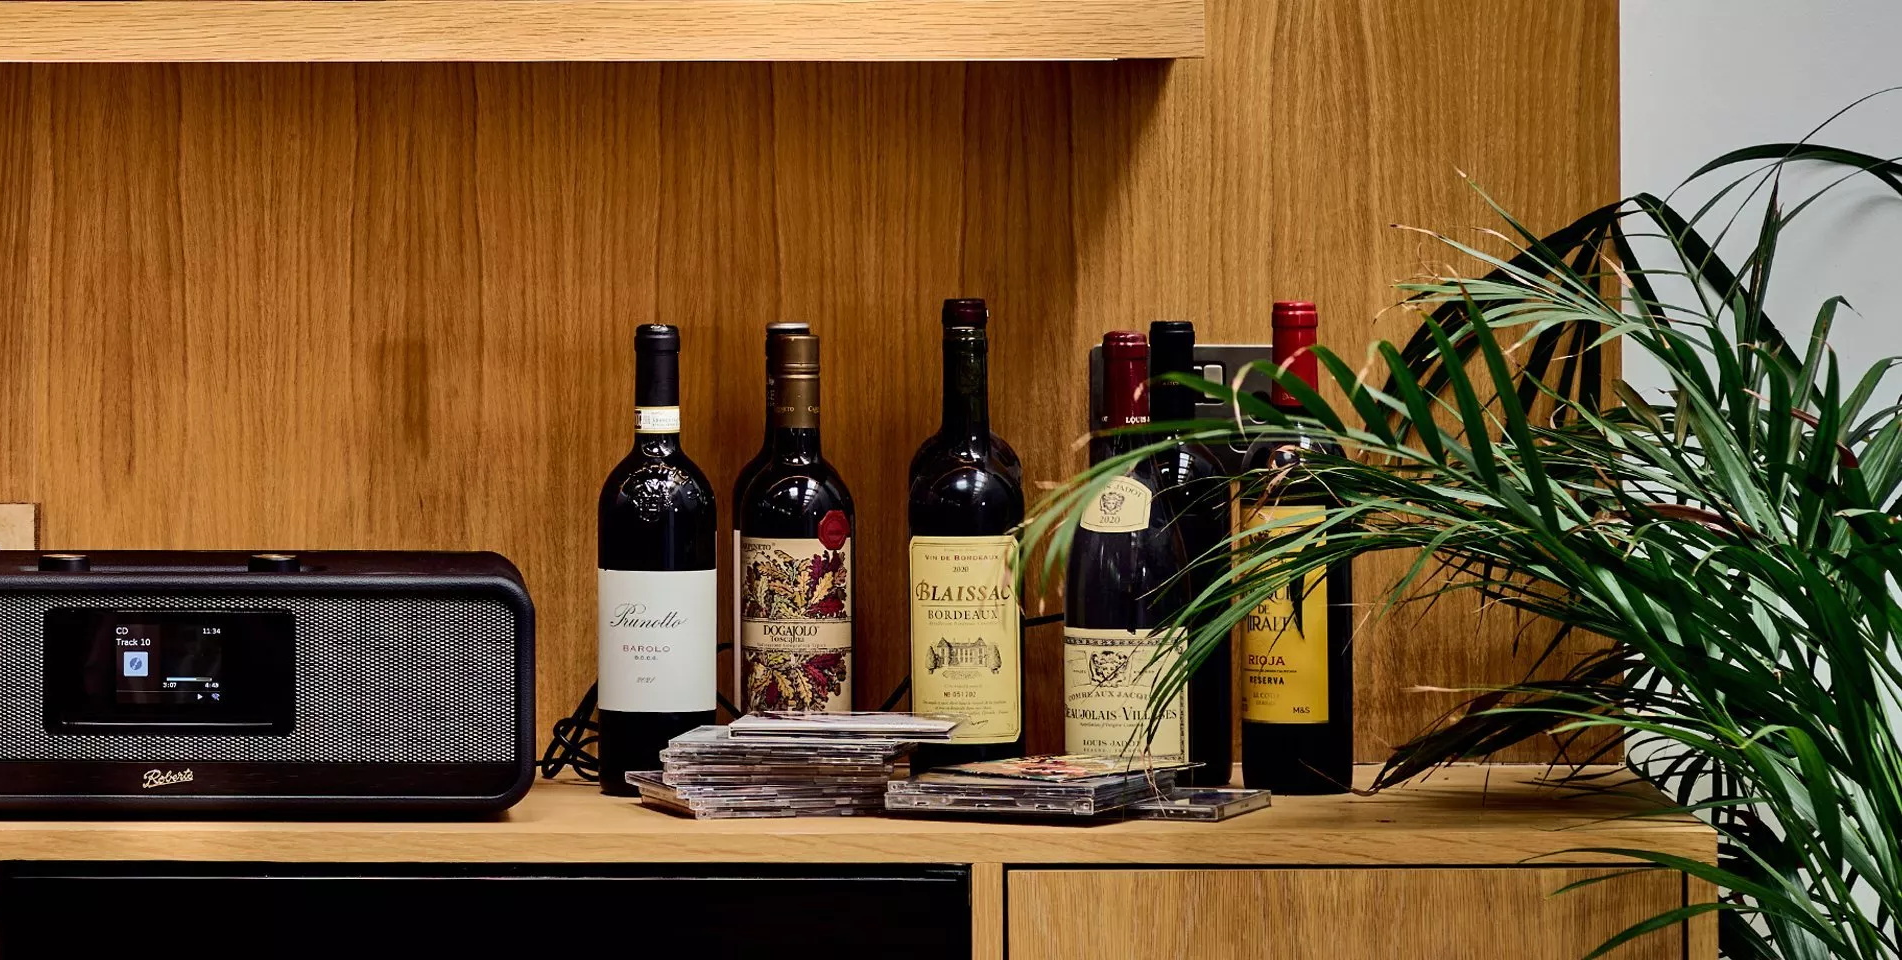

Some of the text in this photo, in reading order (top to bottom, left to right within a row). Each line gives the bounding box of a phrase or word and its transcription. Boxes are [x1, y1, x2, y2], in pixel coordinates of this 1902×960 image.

[1099, 515, 1121, 524] 2020
[915, 579, 1011, 602] BLAISSAC
[1258, 604, 1270, 615] DE
[928, 609, 998, 620] BORDEAUX
[116, 627, 129, 635] CD
[116, 638, 138, 646] Track
[622, 645, 671, 653] BAROLO
[1248, 654, 1286, 666] RIOJA
[1249, 676, 1285, 685] RESERVA
[1094, 690, 1115, 698] AUX
[1293, 706, 1311, 714] M&S
[1083, 739, 1107, 747] LOUIS
[142, 768, 194, 789] Roberts
